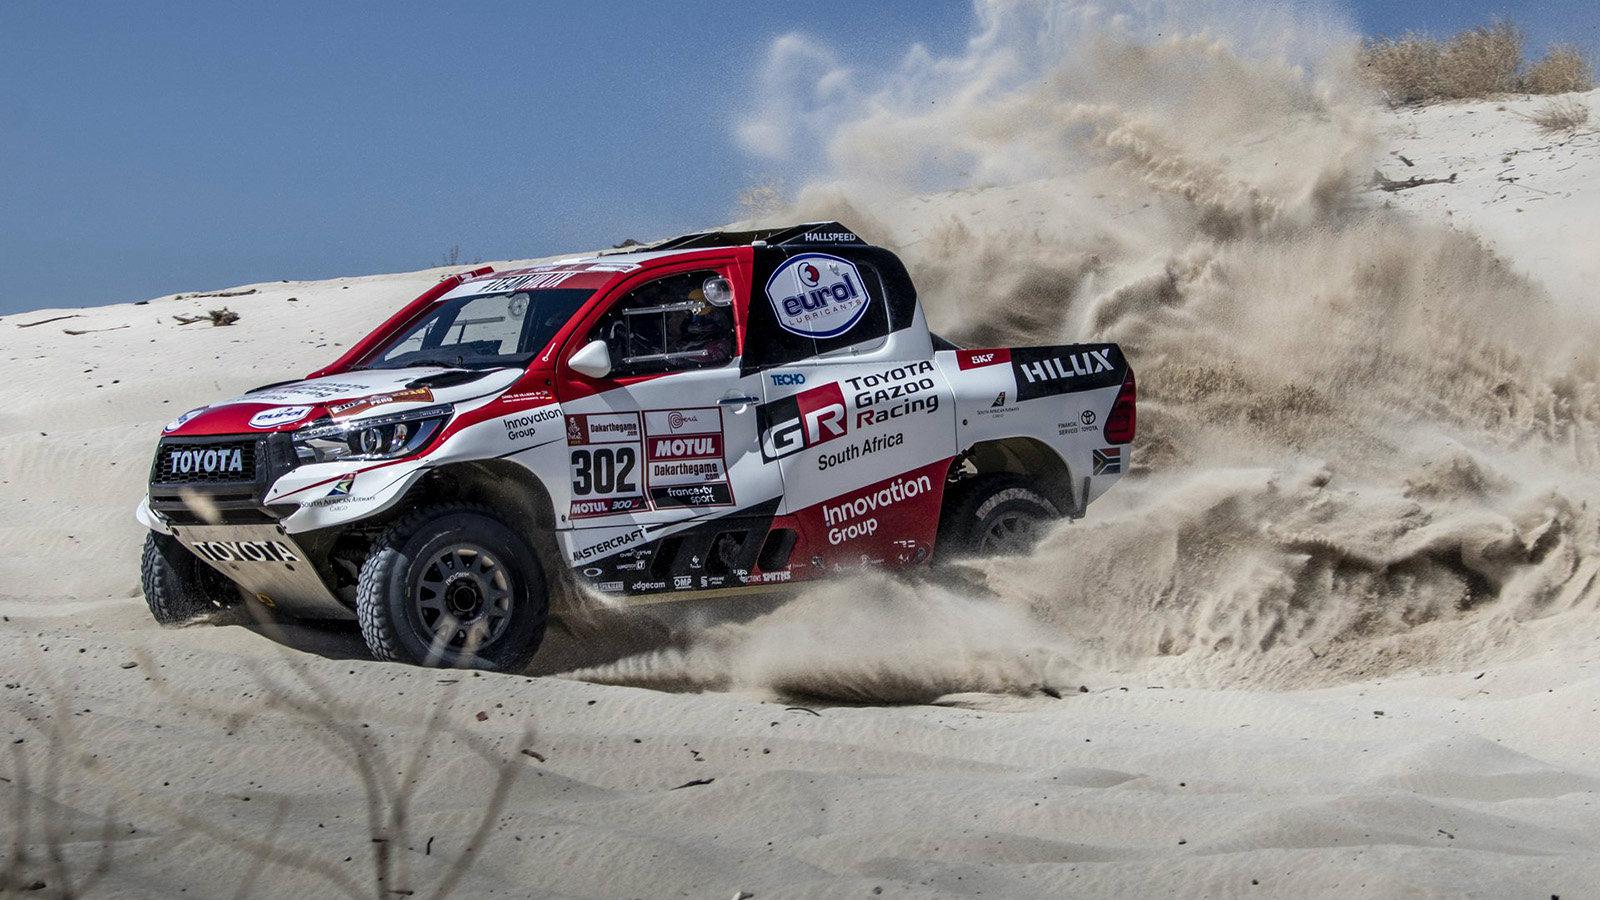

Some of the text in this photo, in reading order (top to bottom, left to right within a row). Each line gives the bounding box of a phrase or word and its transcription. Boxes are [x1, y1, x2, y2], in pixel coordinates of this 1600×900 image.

[805, 233, 856, 242] HALLSPEED
[782, 272, 859, 317] eurol
[788, 299, 862, 326] LUBRICANTS
[971, 353, 994, 364] SKF
[1020, 349, 1114, 383] HILUX
[771, 373, 806, 386] TECHO
[845, 360, 934, 391] TOYOTA
[855, 378, 934, 409] GAZOO
[856, 395, 939, 430] Racing
[508, 426, 536, 441] Group
[590, 422, 637, 434] Dakarthegame
[763, 403, 845, 458] GR
[655, 437, 716, 457] MOTUL
[818, 432, 904, 471] South Africa
[170, 449, 243, 473] TOYOTA
[571, 447, 637, 496] 302
[654, 462, 718, 478] Dakarthegame
[571, 501, 608, 514] MOTUL
[690, 493, 715, 505] sport
[828, 518, 878, 545] Group
[190, 541, 301, 562] TOYOTA
[674, 578, 692, 588] OMP
